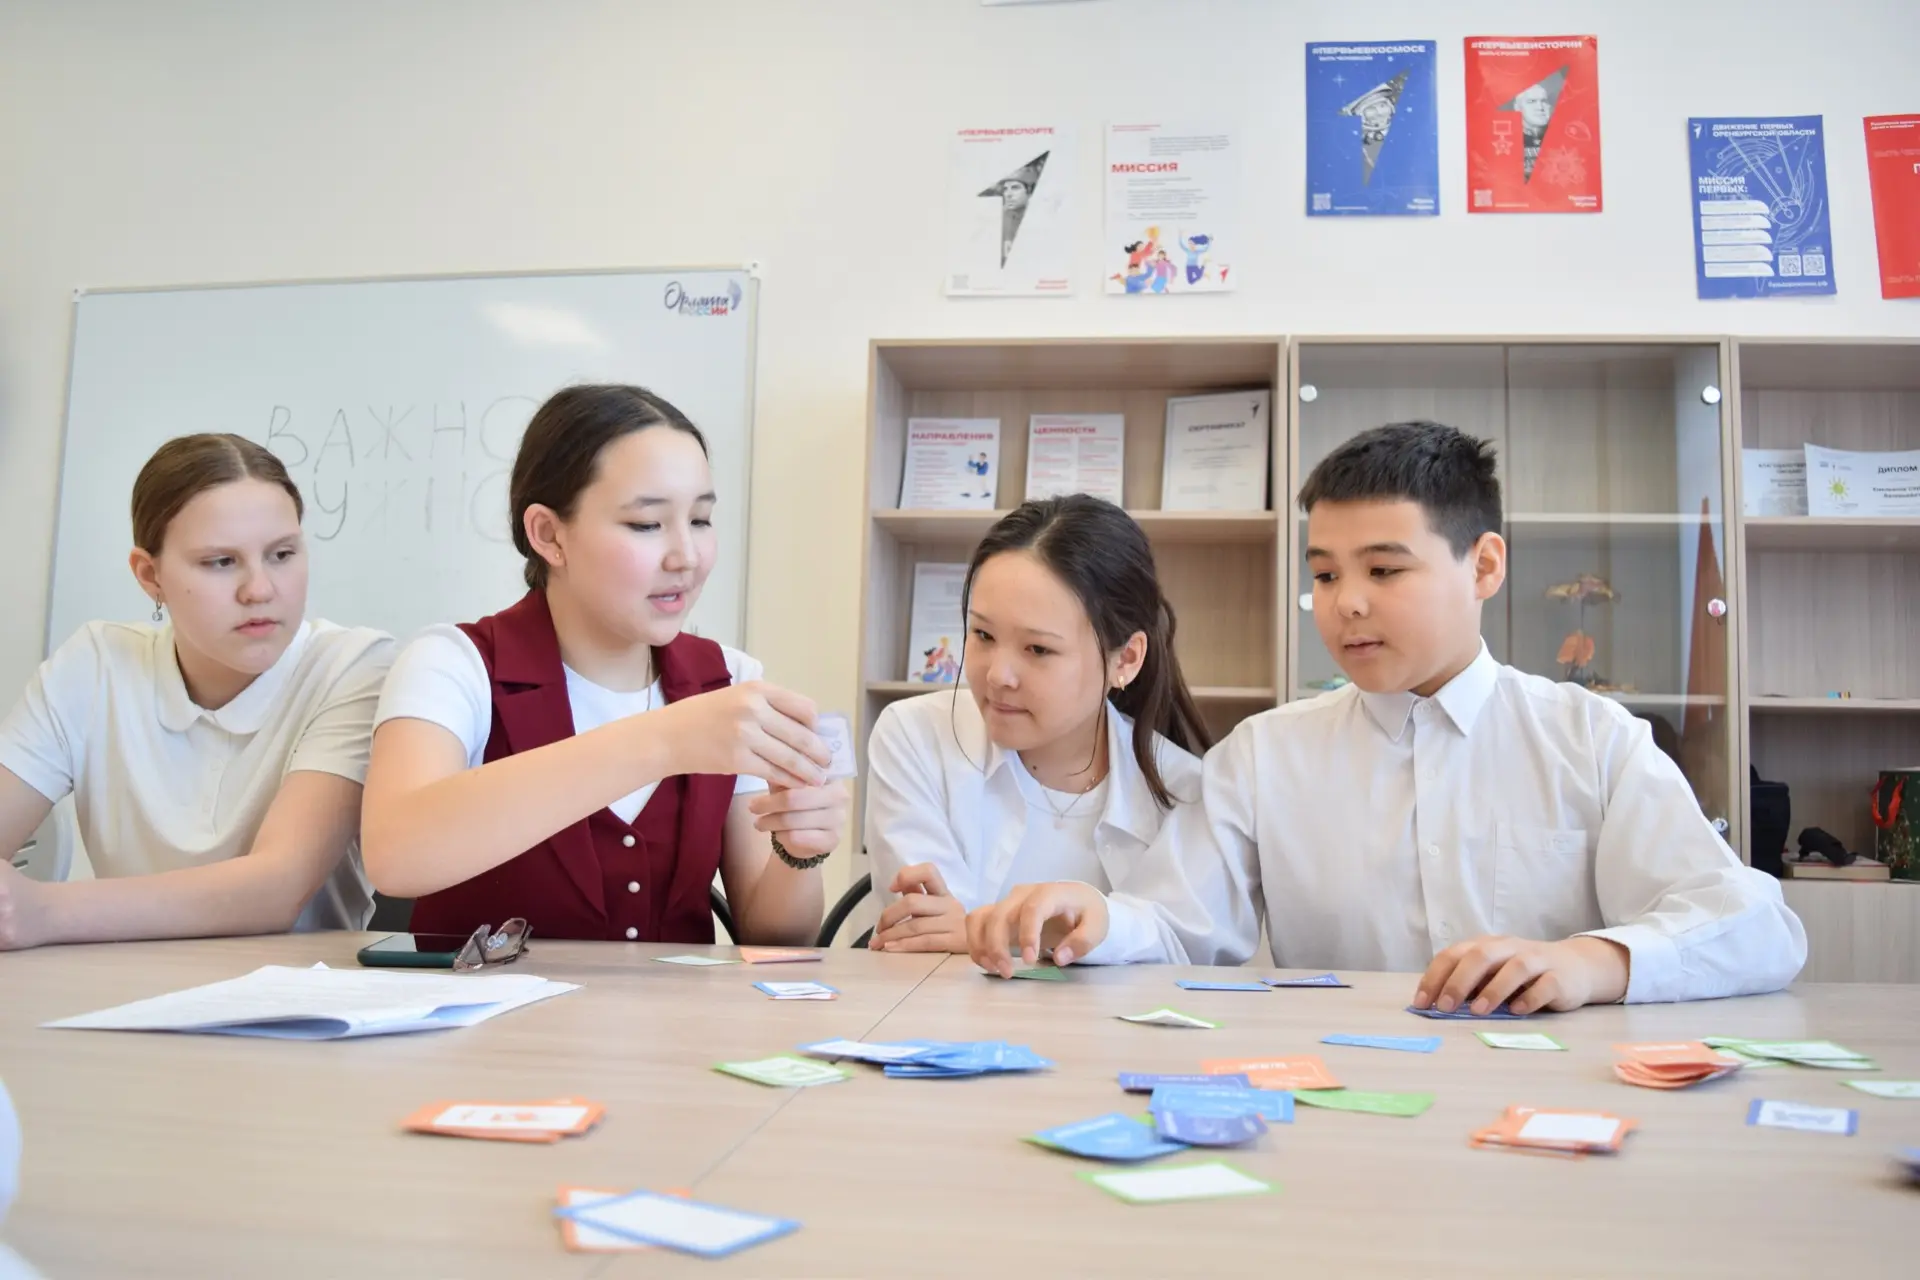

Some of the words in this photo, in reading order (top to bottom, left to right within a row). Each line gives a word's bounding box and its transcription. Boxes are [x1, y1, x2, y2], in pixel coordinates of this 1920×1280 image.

[1111, 162, 1179, 173] МИССИЯ
[1698, 176, 1745, 185] МИССИЯ
[1698, 185, 1748, 193] ПЕРВЫХ:
[1034, 427, 1097, 435] ЦЕННОСТИ
[911, 432, 994, 441] НАПРАВЛЕНИЯ
[1877, 466, 1918, 475] ДИПЛОМ
